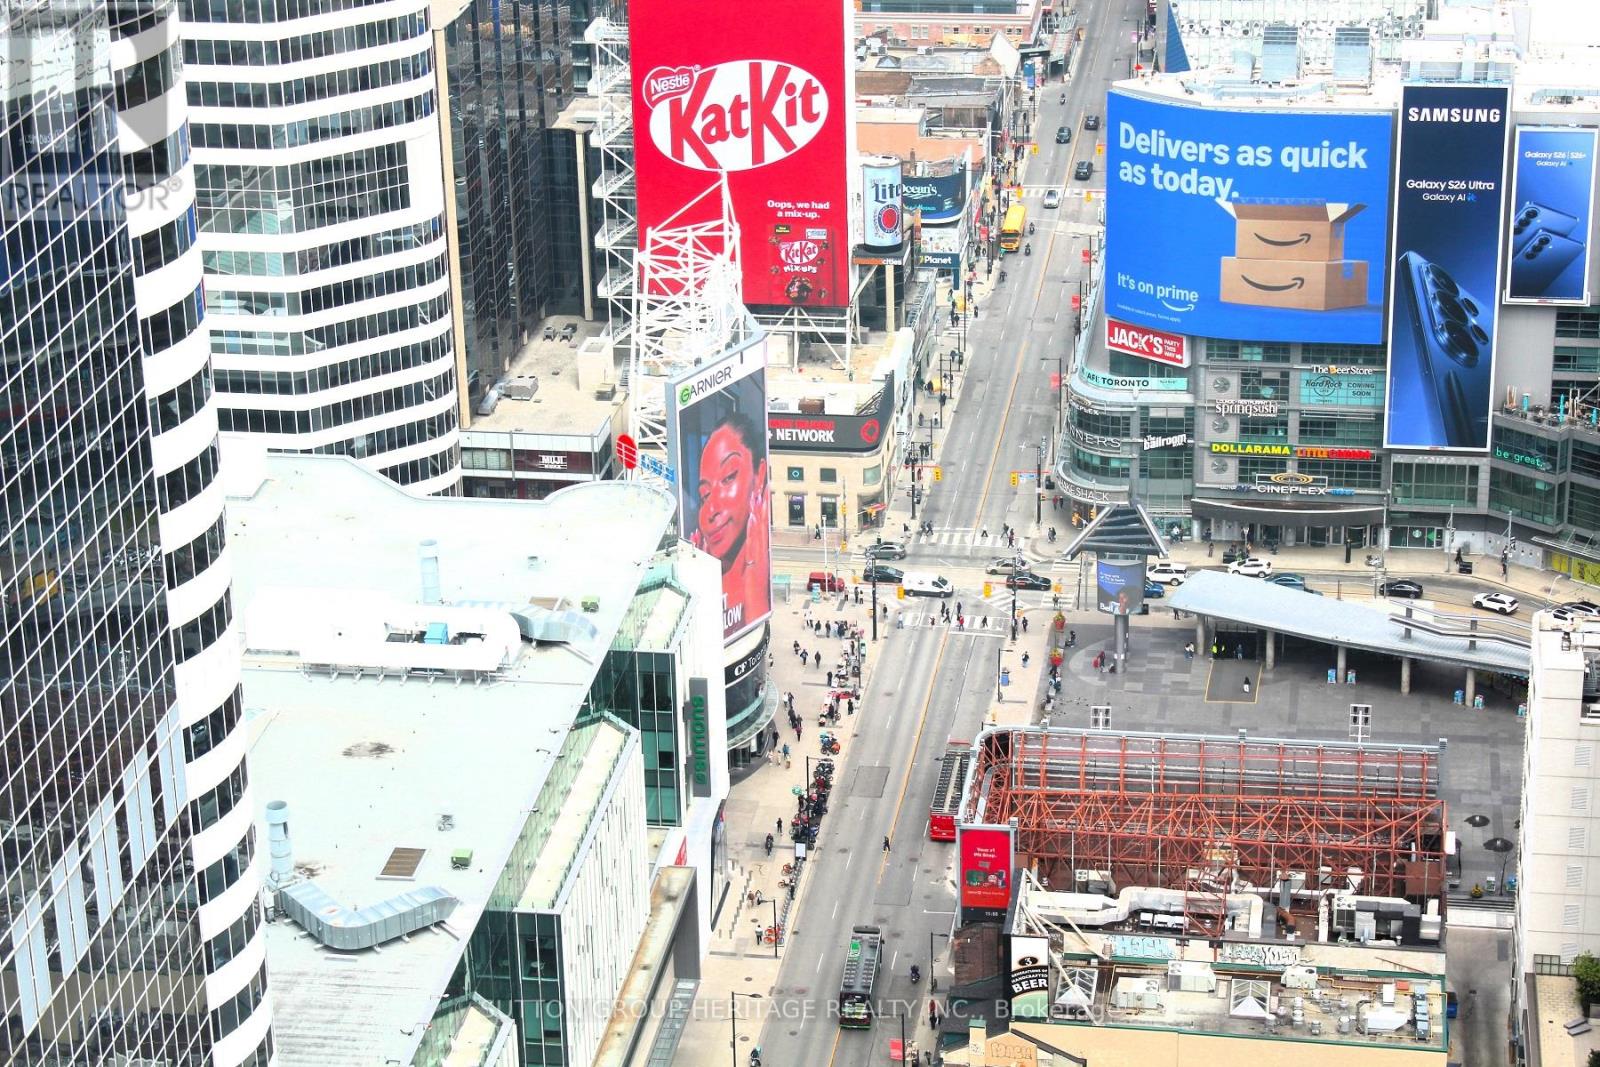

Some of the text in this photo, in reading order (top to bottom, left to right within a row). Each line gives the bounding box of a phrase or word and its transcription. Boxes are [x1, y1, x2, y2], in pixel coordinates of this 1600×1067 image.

[1408, 107, 1500, 123] SAMSUNG
[1119, 121, 1368, 173] Delivers as quick
[1119, 160, 1240, 200] as today.
[1406, 179, 1494, 191] Galaxy S26 Ultra
[1422, 193, 1455, 203] Galaxy
[767, 200, 796, 209] Oops,
[1117, 272, 1199, 303] It's on prime
[1110, 327, 1163, 355] JACK'S
[1311, 364, 1328, 374] The
[1350, 365, 1373, 375] Store
[1102, 376, 1150, 387] TORONTO
[776, 428, 835, 442] NETWORK
[1211, 443, 1291, 455] DOLLARAMA
[1496, 446, 1510, 459] be
[1257, 485, 1327, 495] CINEPLEX
[1025, 957, 1033, 966] 3
[1011, 978, 1048, 993] BEER
